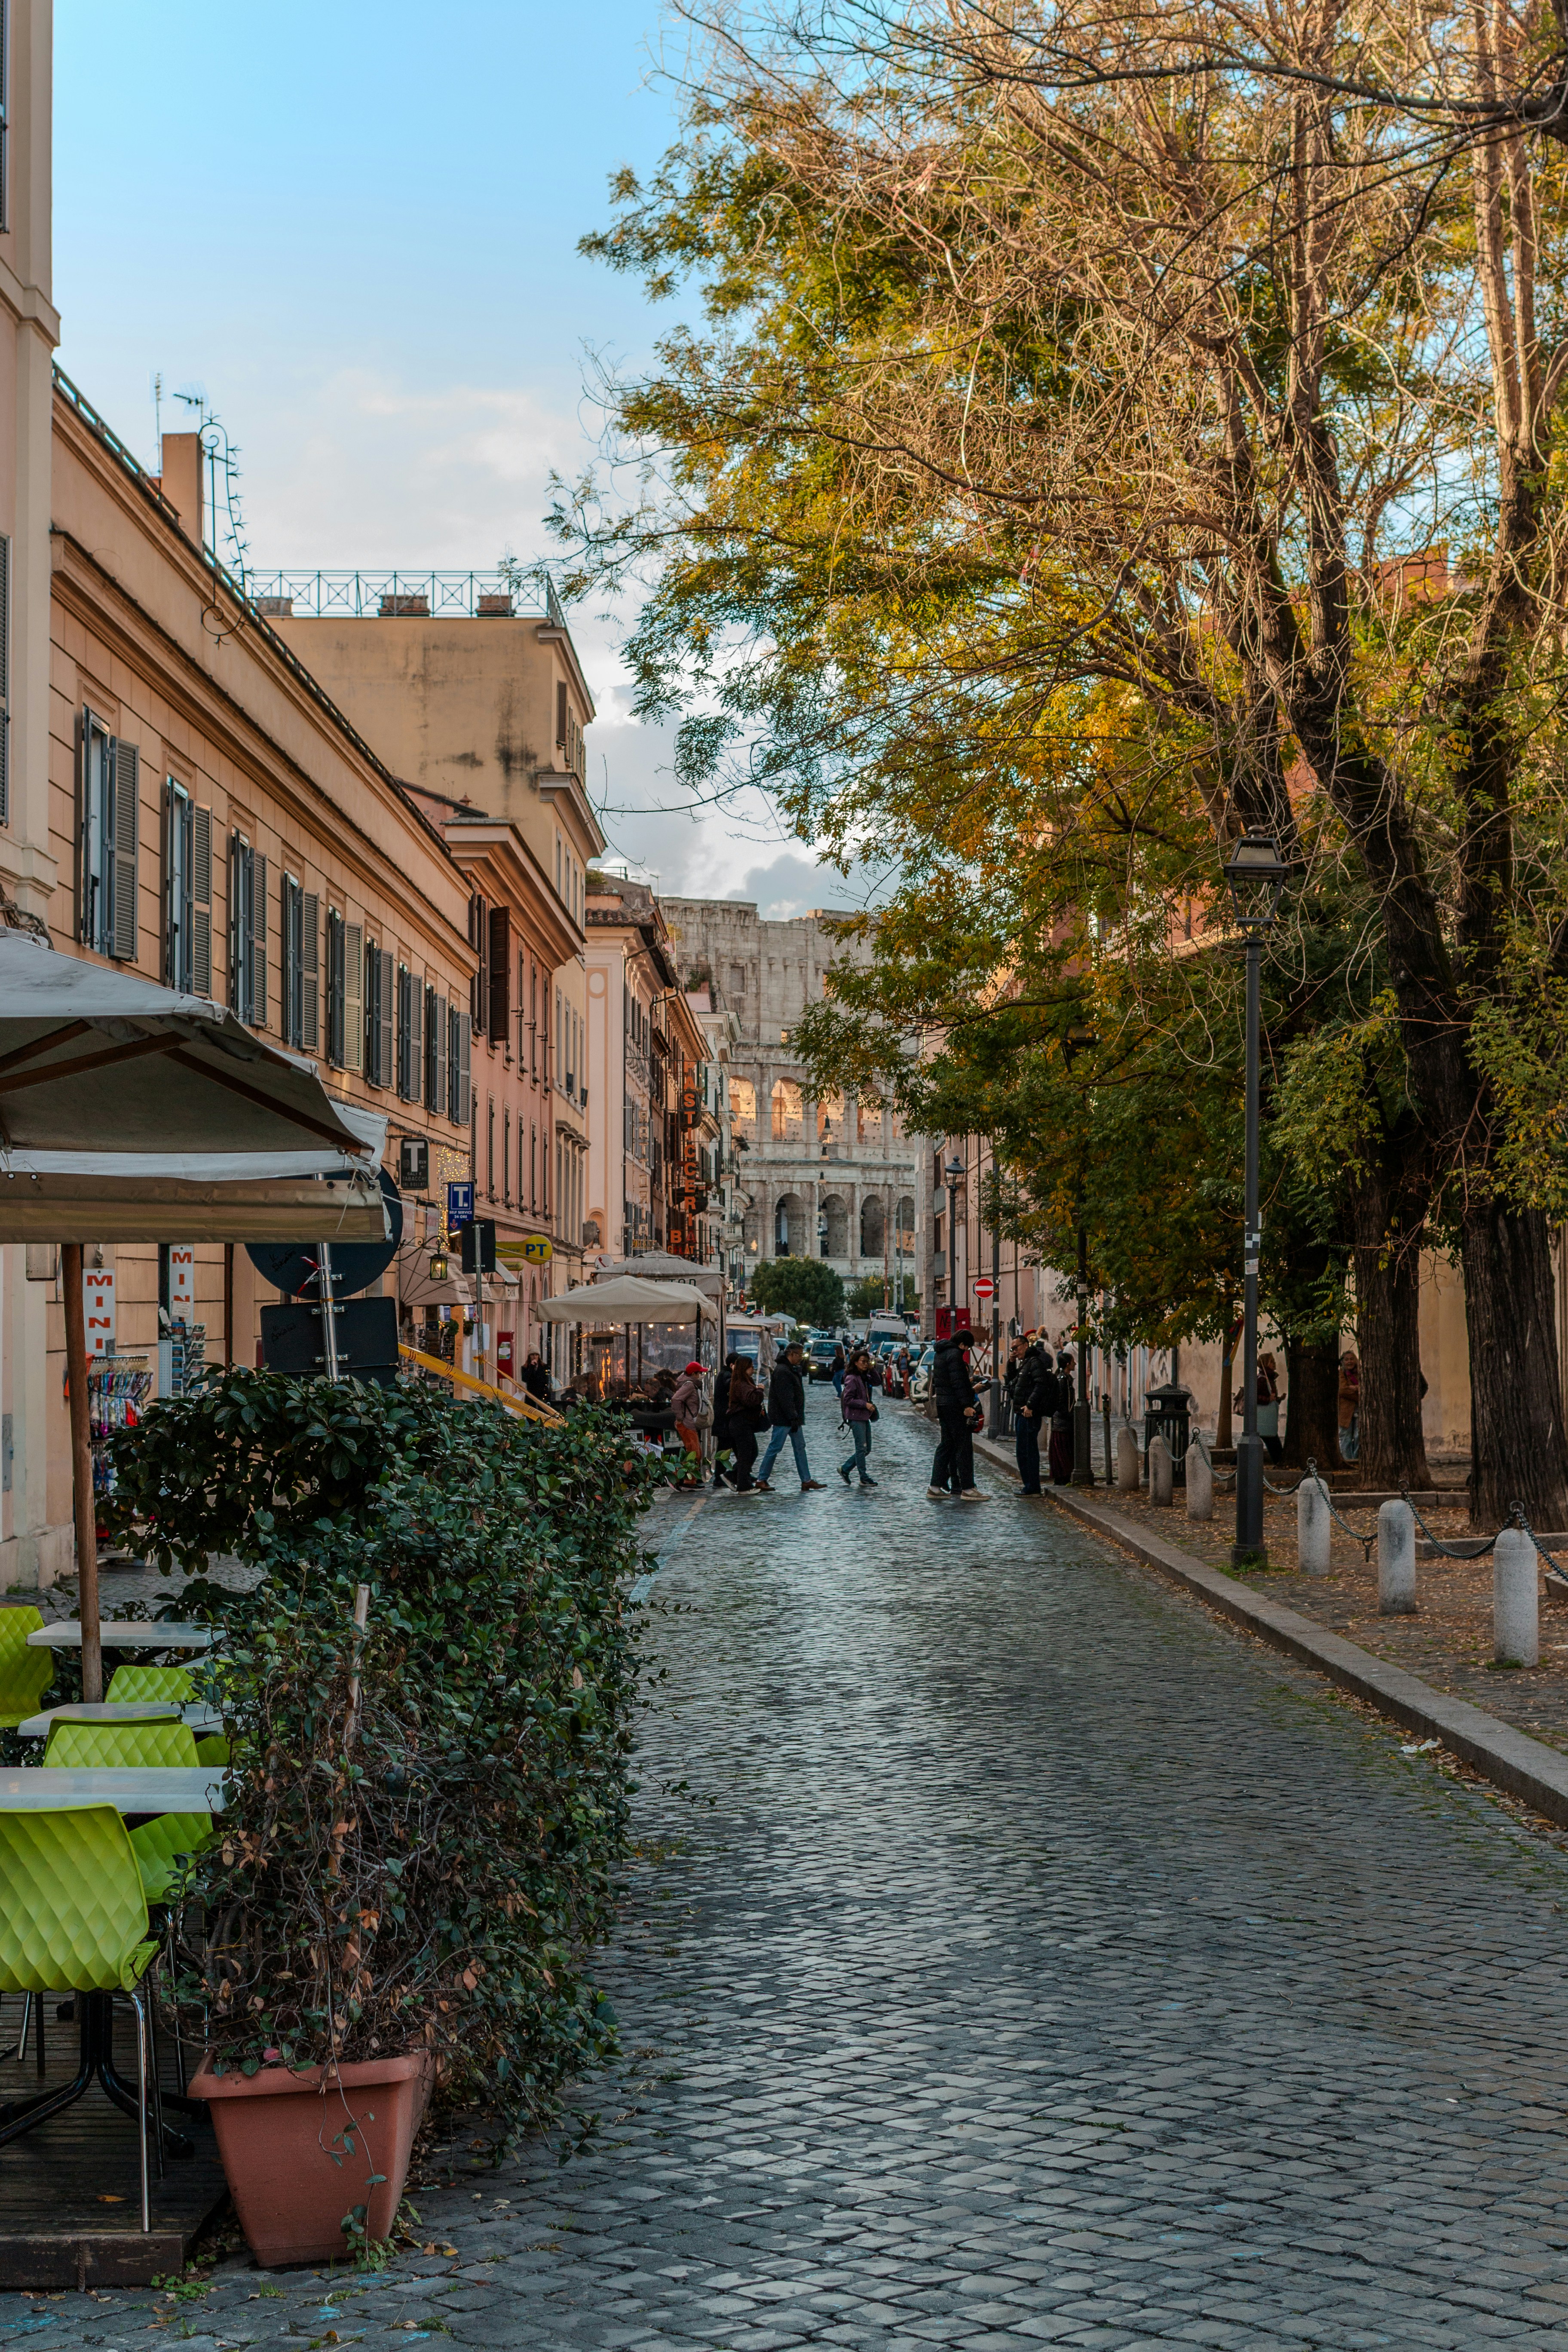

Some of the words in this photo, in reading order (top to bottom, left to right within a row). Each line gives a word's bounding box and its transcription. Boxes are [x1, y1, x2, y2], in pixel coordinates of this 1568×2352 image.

[404, 1142, 425, 1172] T
[526, 1244, 547, 1256] PT
[87, 1275, 113, 1349] MINI
